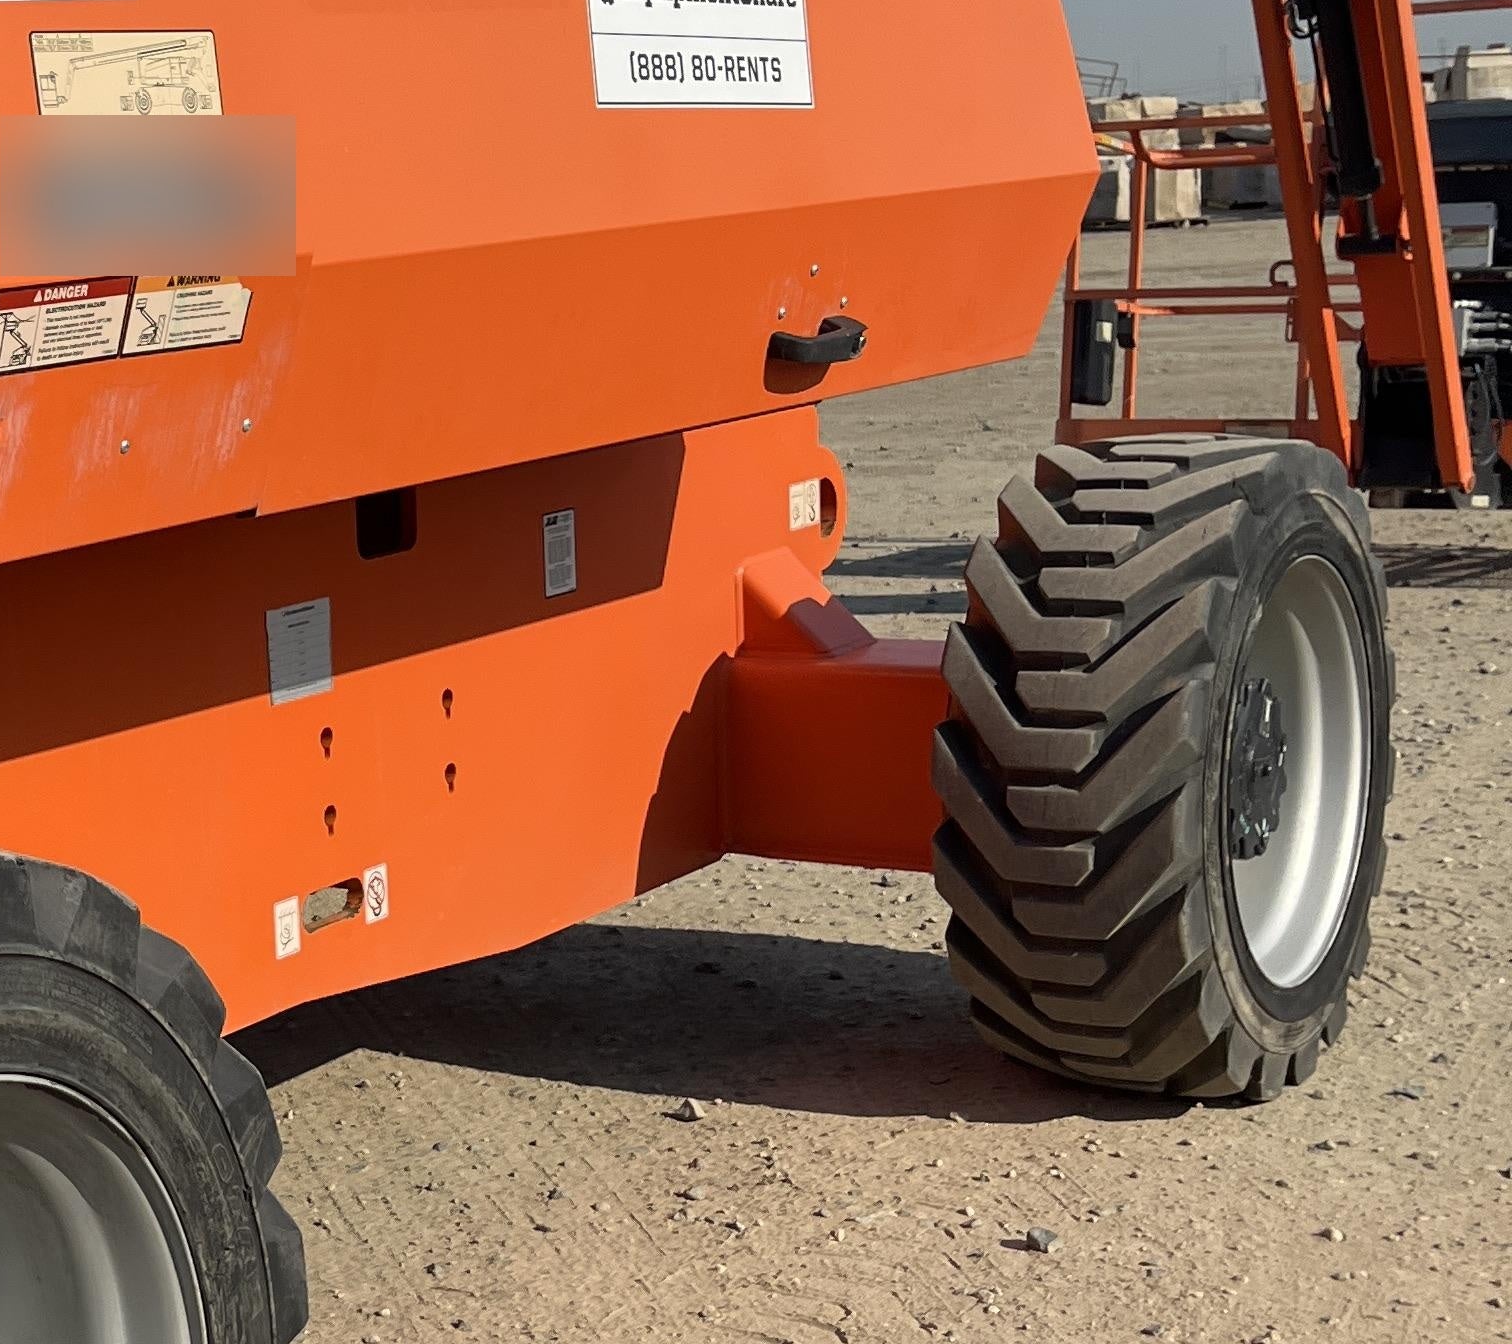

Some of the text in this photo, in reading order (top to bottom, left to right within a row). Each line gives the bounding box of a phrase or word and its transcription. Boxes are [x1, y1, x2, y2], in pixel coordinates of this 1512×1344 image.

[629, 50, 782, 83] (888) 80-RENTS
[43, 285, 89, 302] DANGER
